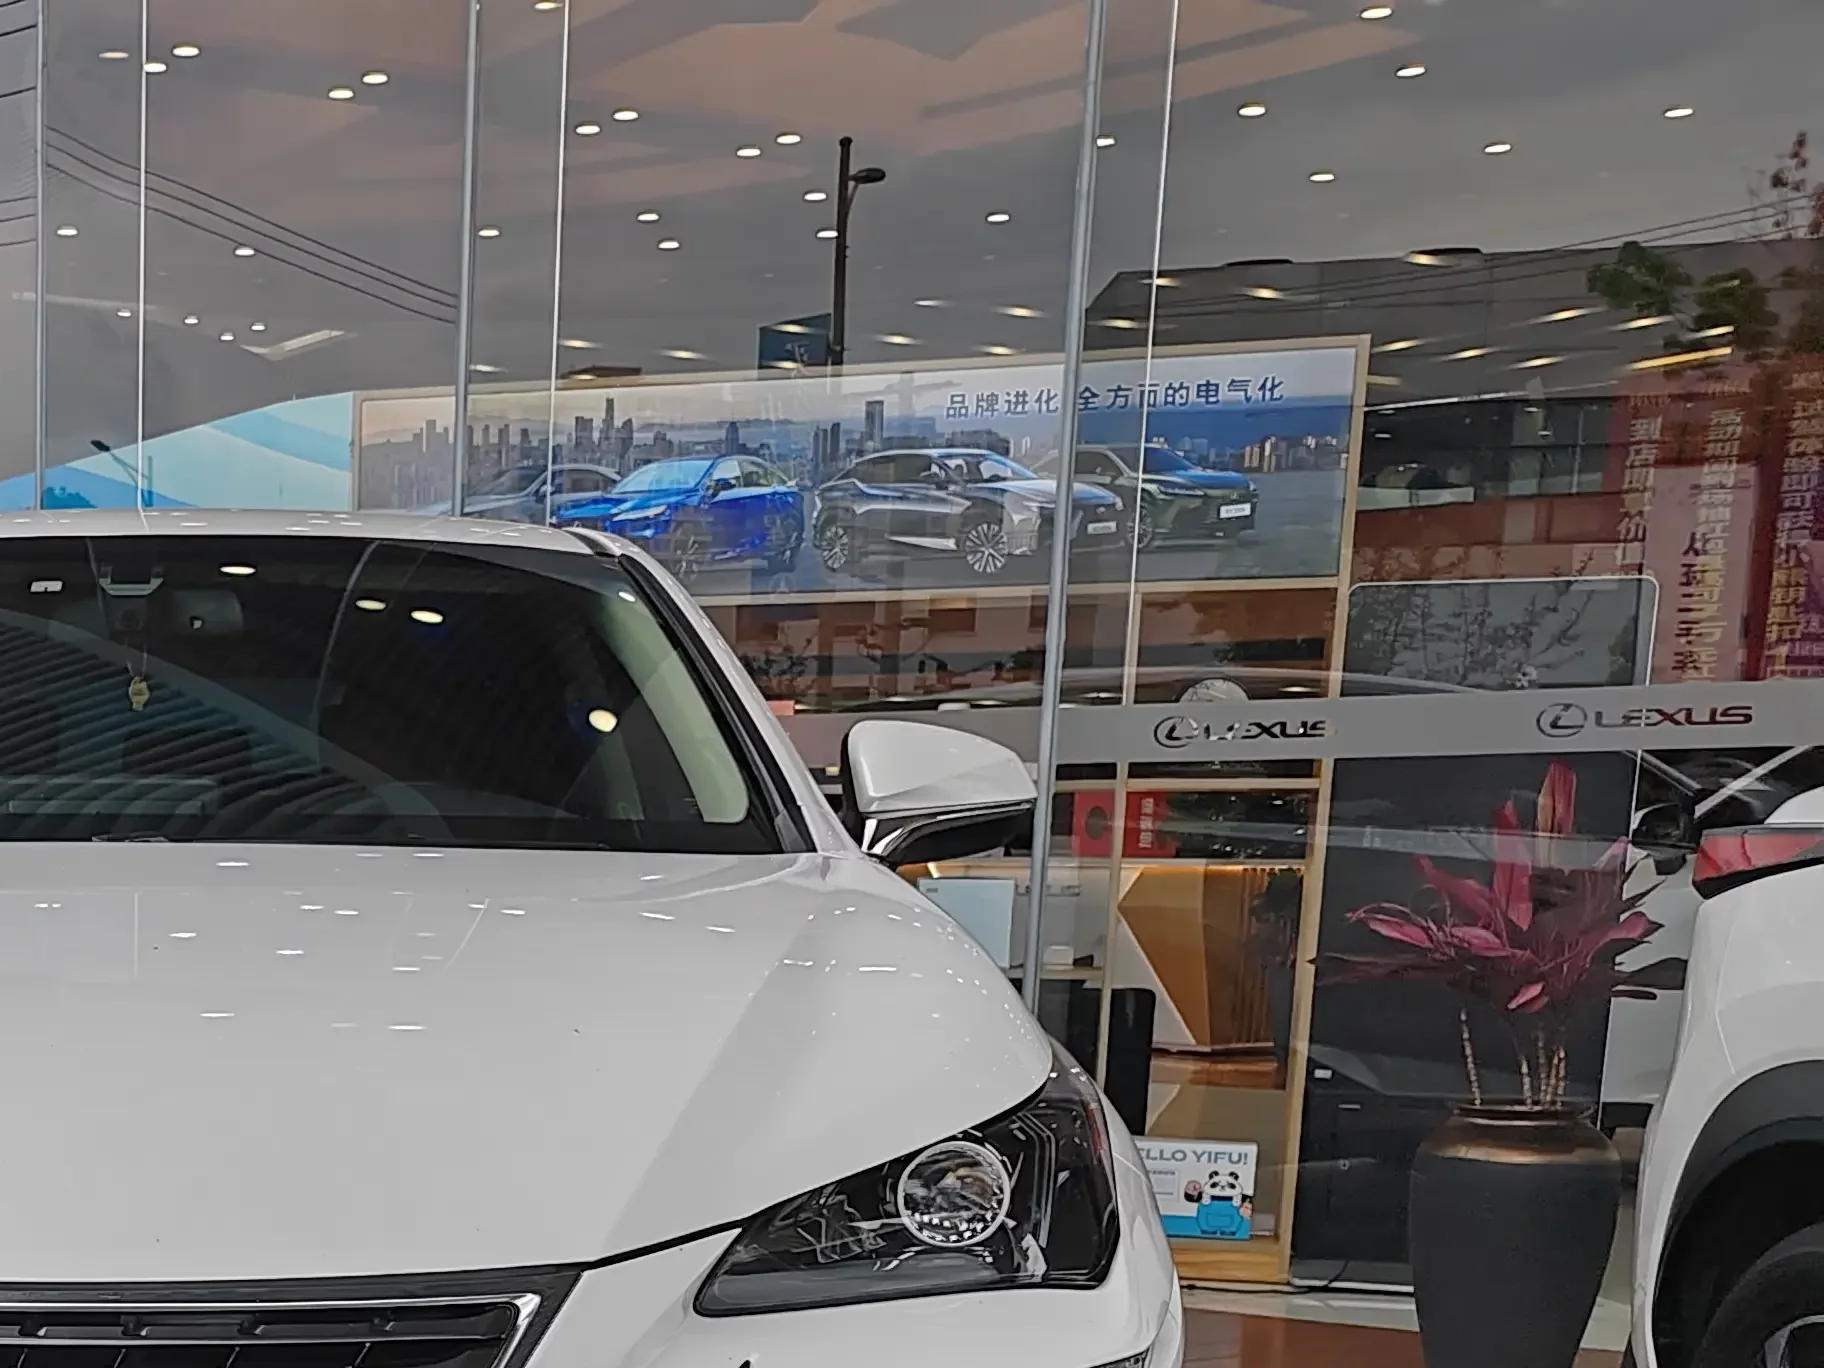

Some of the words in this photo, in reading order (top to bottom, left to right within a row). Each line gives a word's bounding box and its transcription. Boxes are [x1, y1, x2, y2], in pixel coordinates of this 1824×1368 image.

[945, 387, 1059, 419] 品牌进化
[1594, 705, 1753, 728] LEXUS
[1192, 1150, 1248, 1166] YIFU!
